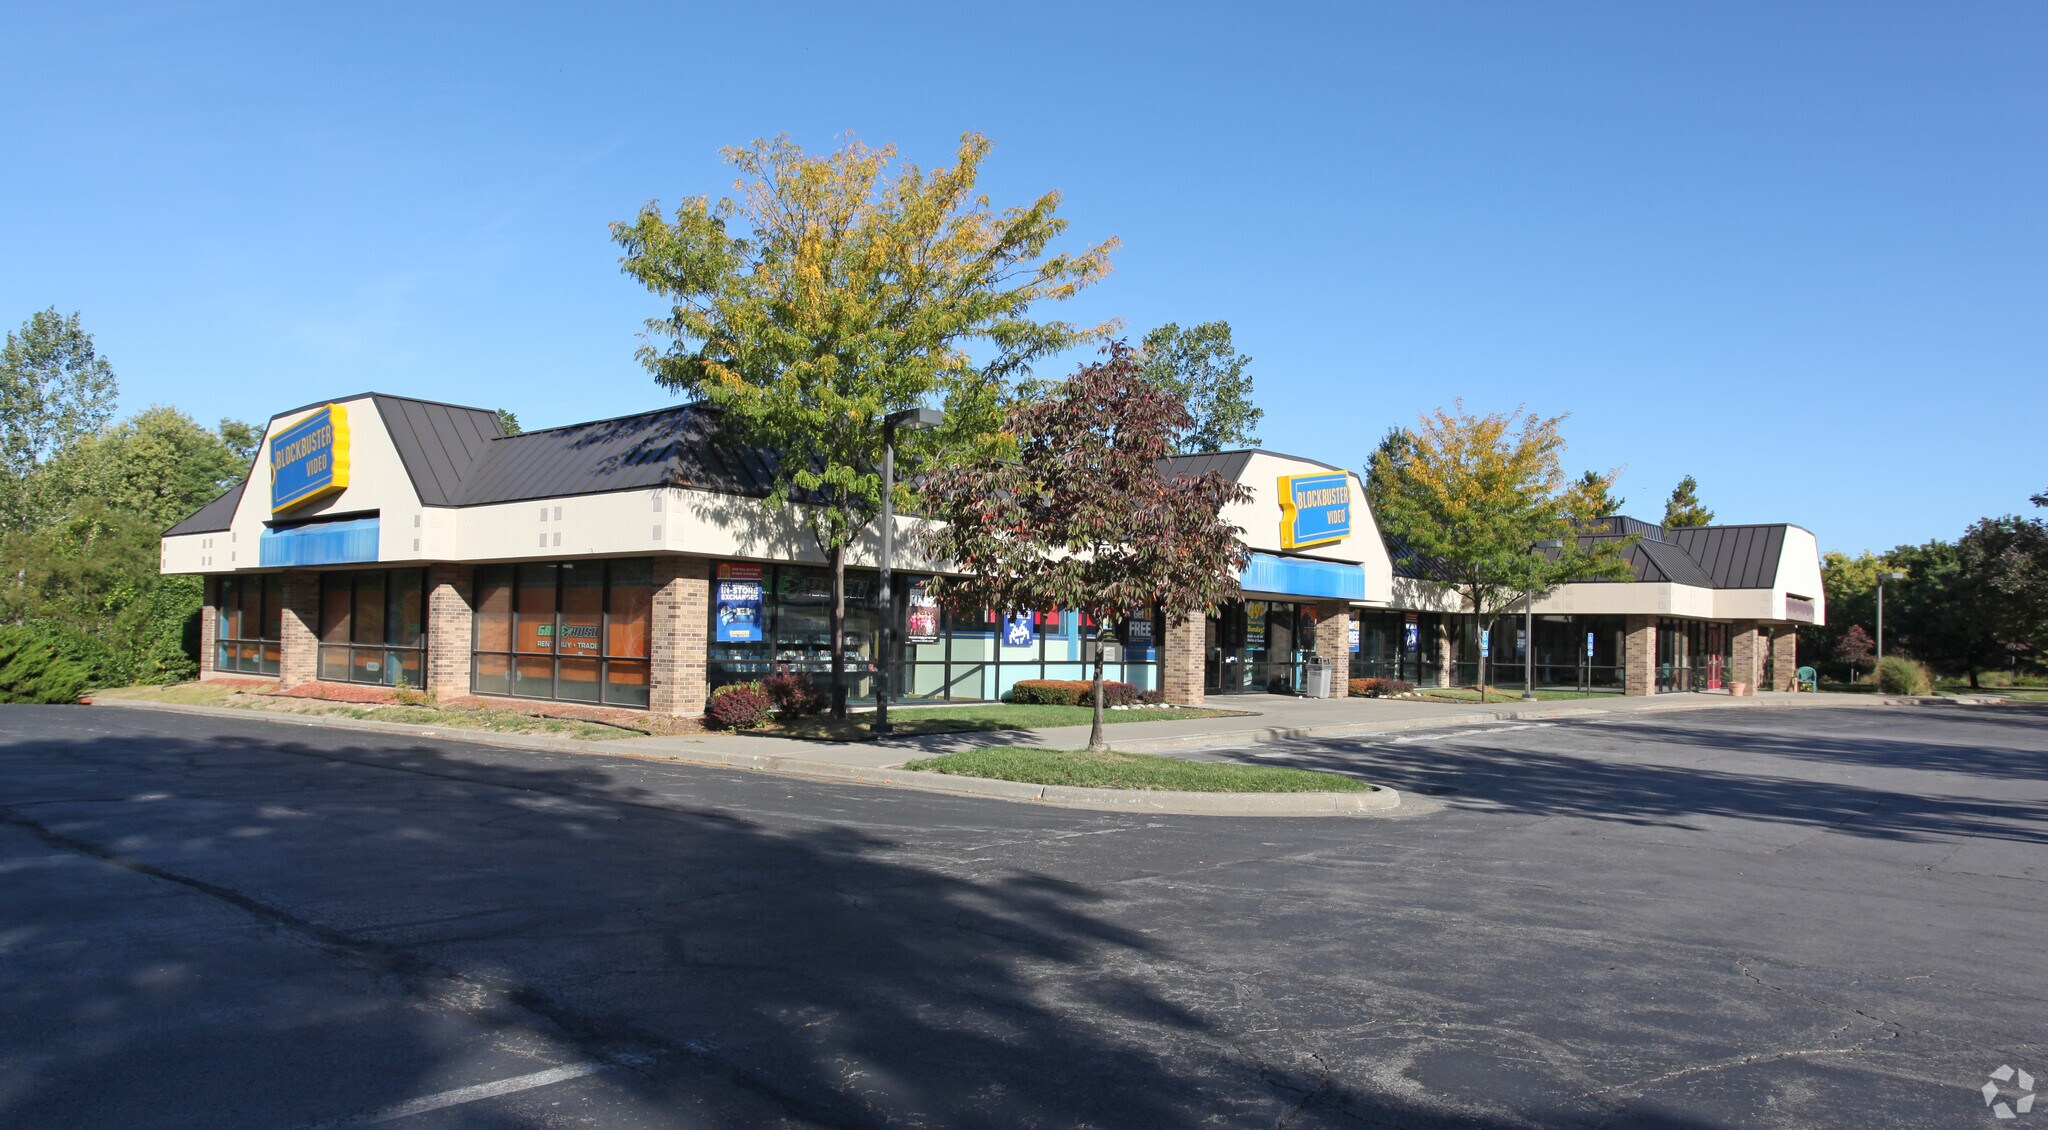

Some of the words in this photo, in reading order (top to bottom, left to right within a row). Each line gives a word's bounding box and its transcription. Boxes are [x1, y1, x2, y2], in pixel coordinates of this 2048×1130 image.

[276, 424, 332, 470] BLOCKBUSTER
[306, 453, 327, 477] VIDEO
[1297, 486, 1349, 510] BLOCKBUSTER
[1326, 509, 1346, 525] VIDEO
[720, 587, 759, 595] IN-STORE
[1129, 621, 1152, 637] FREE
[577, 642, 599, 650] TRADE
